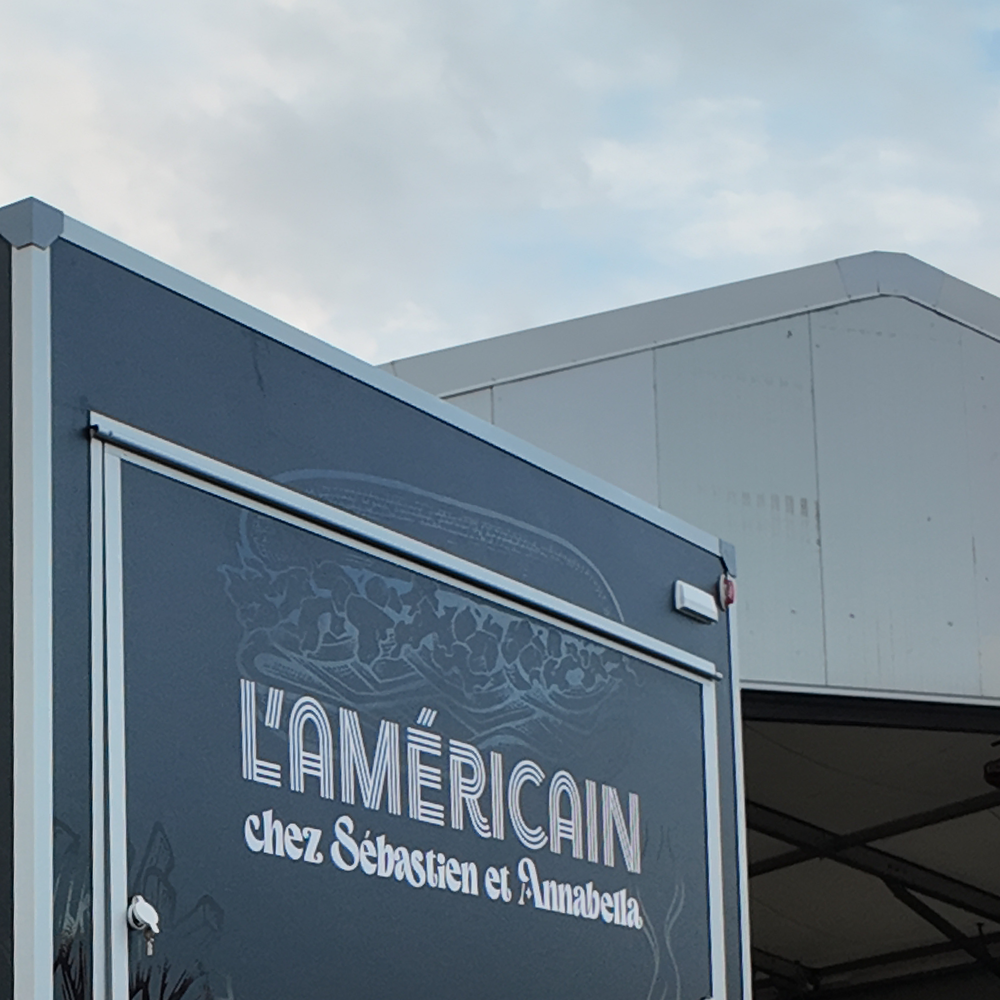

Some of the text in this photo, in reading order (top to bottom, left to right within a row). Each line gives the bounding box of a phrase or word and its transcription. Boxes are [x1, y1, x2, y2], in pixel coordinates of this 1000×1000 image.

[240, 678, 641, 874] L'AMÉRICAIN
[244, 809, 643, 929] chez Sébastien et Annabella
